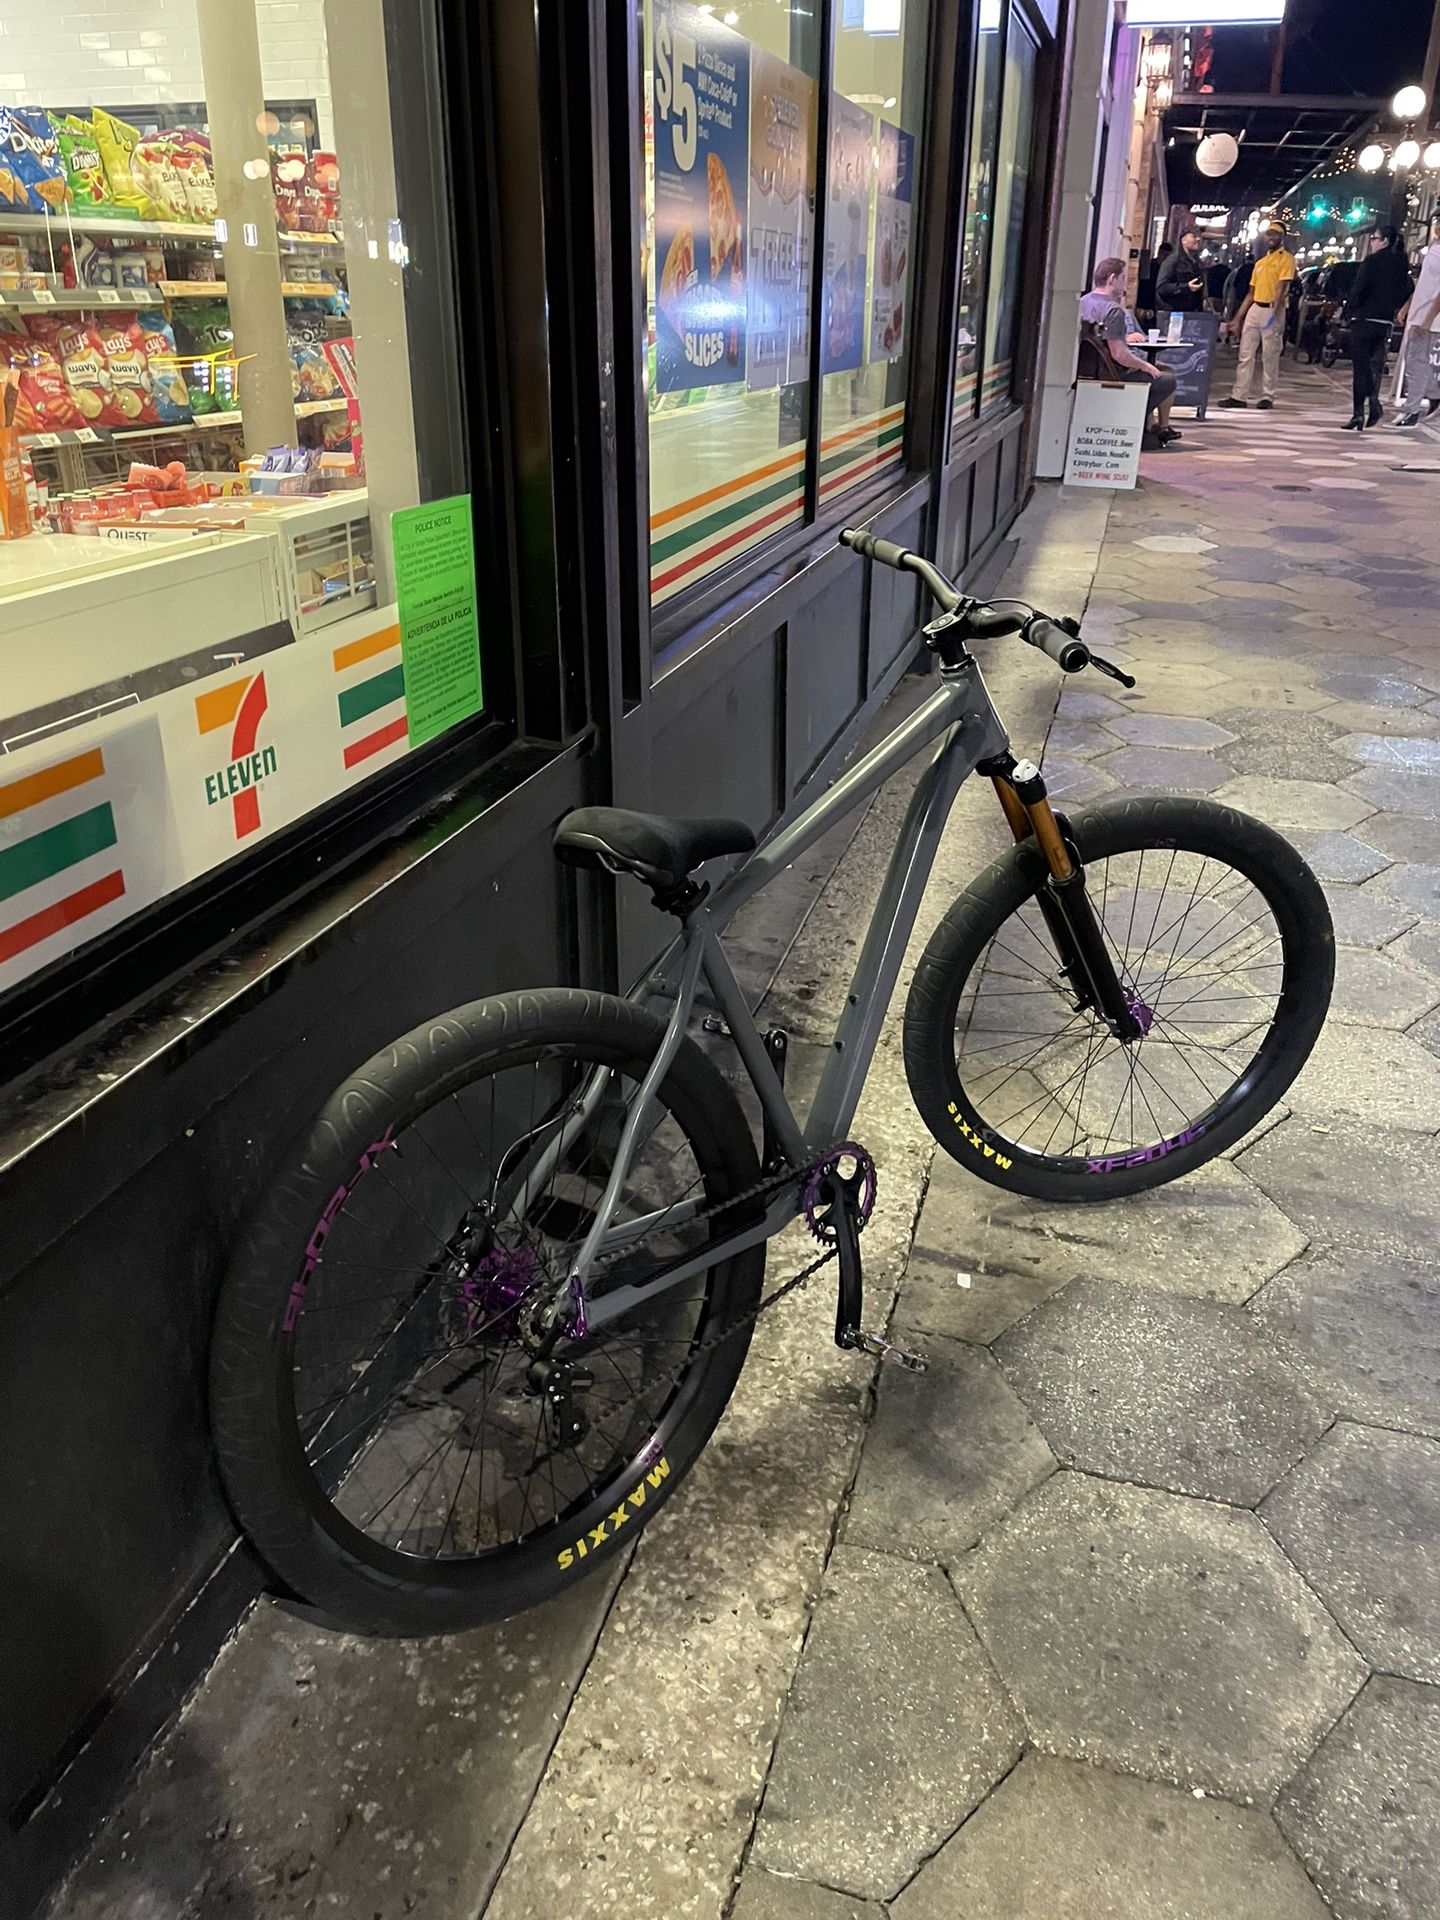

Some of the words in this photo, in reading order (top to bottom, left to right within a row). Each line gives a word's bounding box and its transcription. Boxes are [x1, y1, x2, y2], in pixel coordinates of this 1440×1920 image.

[655, 12, 697, 172] $5
[59, 332, 90, 357] Lay's
[103, 335, 132, 355] Lay's
[685, 331, 724, 368] SLICES
[68, 363, 97, 374] wavy
[111, 365, 140, 375] wavy
[415, 520, 433, 534] POLICE
[433, 515, 452, 527] NOTICE
[195, 670, 268, 840] 7
[947, 1101, 1013, 1170] MAXXIS
[557, 1456, 671, 1570] MAXXIS
